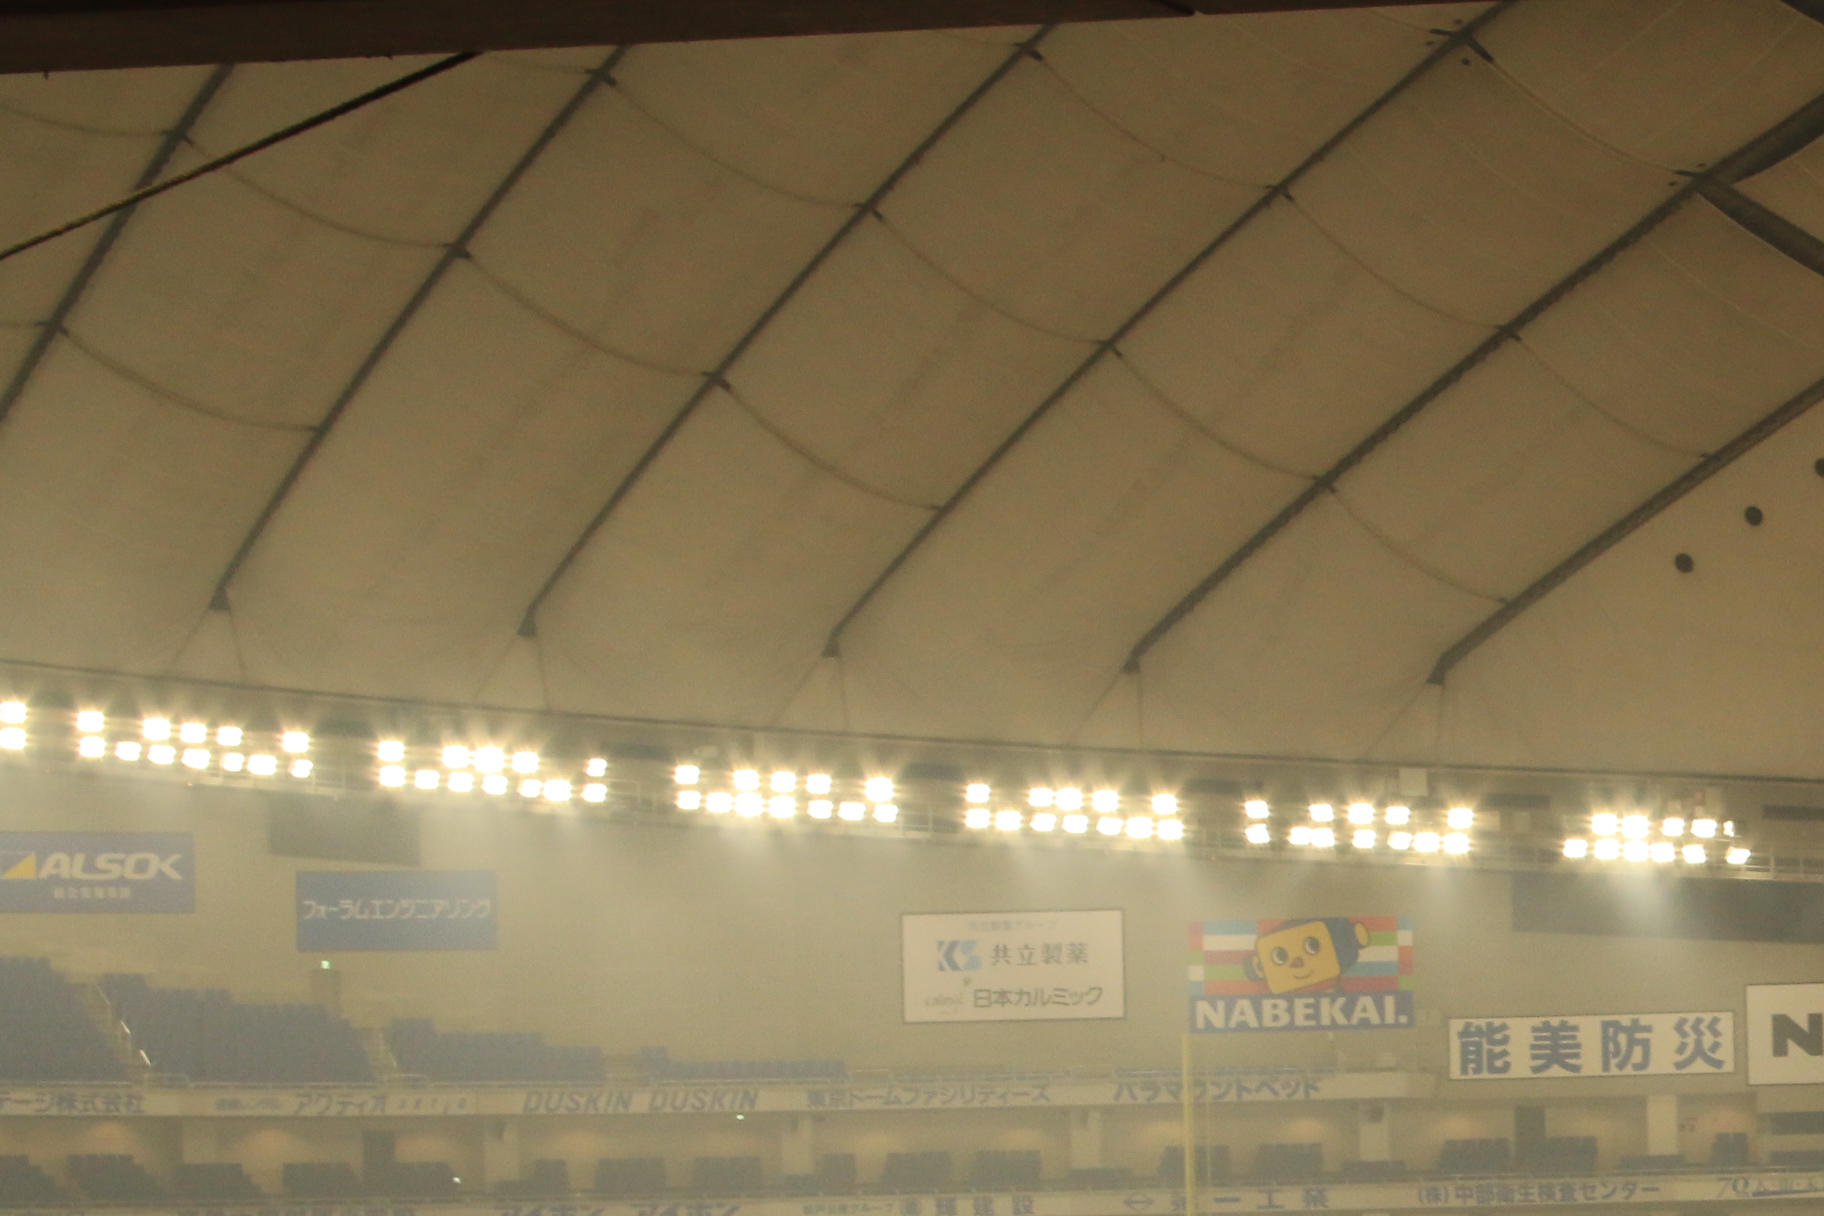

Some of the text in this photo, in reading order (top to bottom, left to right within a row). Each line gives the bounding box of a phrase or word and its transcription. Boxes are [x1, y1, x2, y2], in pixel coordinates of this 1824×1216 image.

[38, 851, 184, 882] ALSOK
[991, 943, 1089, 966] 共立製薬
[973, 987, 1103, 1009] 日本カルミック
[1457, 1017, 1725, 1075] 能美防災
[523, 1088, 759, 1114] DUSKIN DUSKIN
